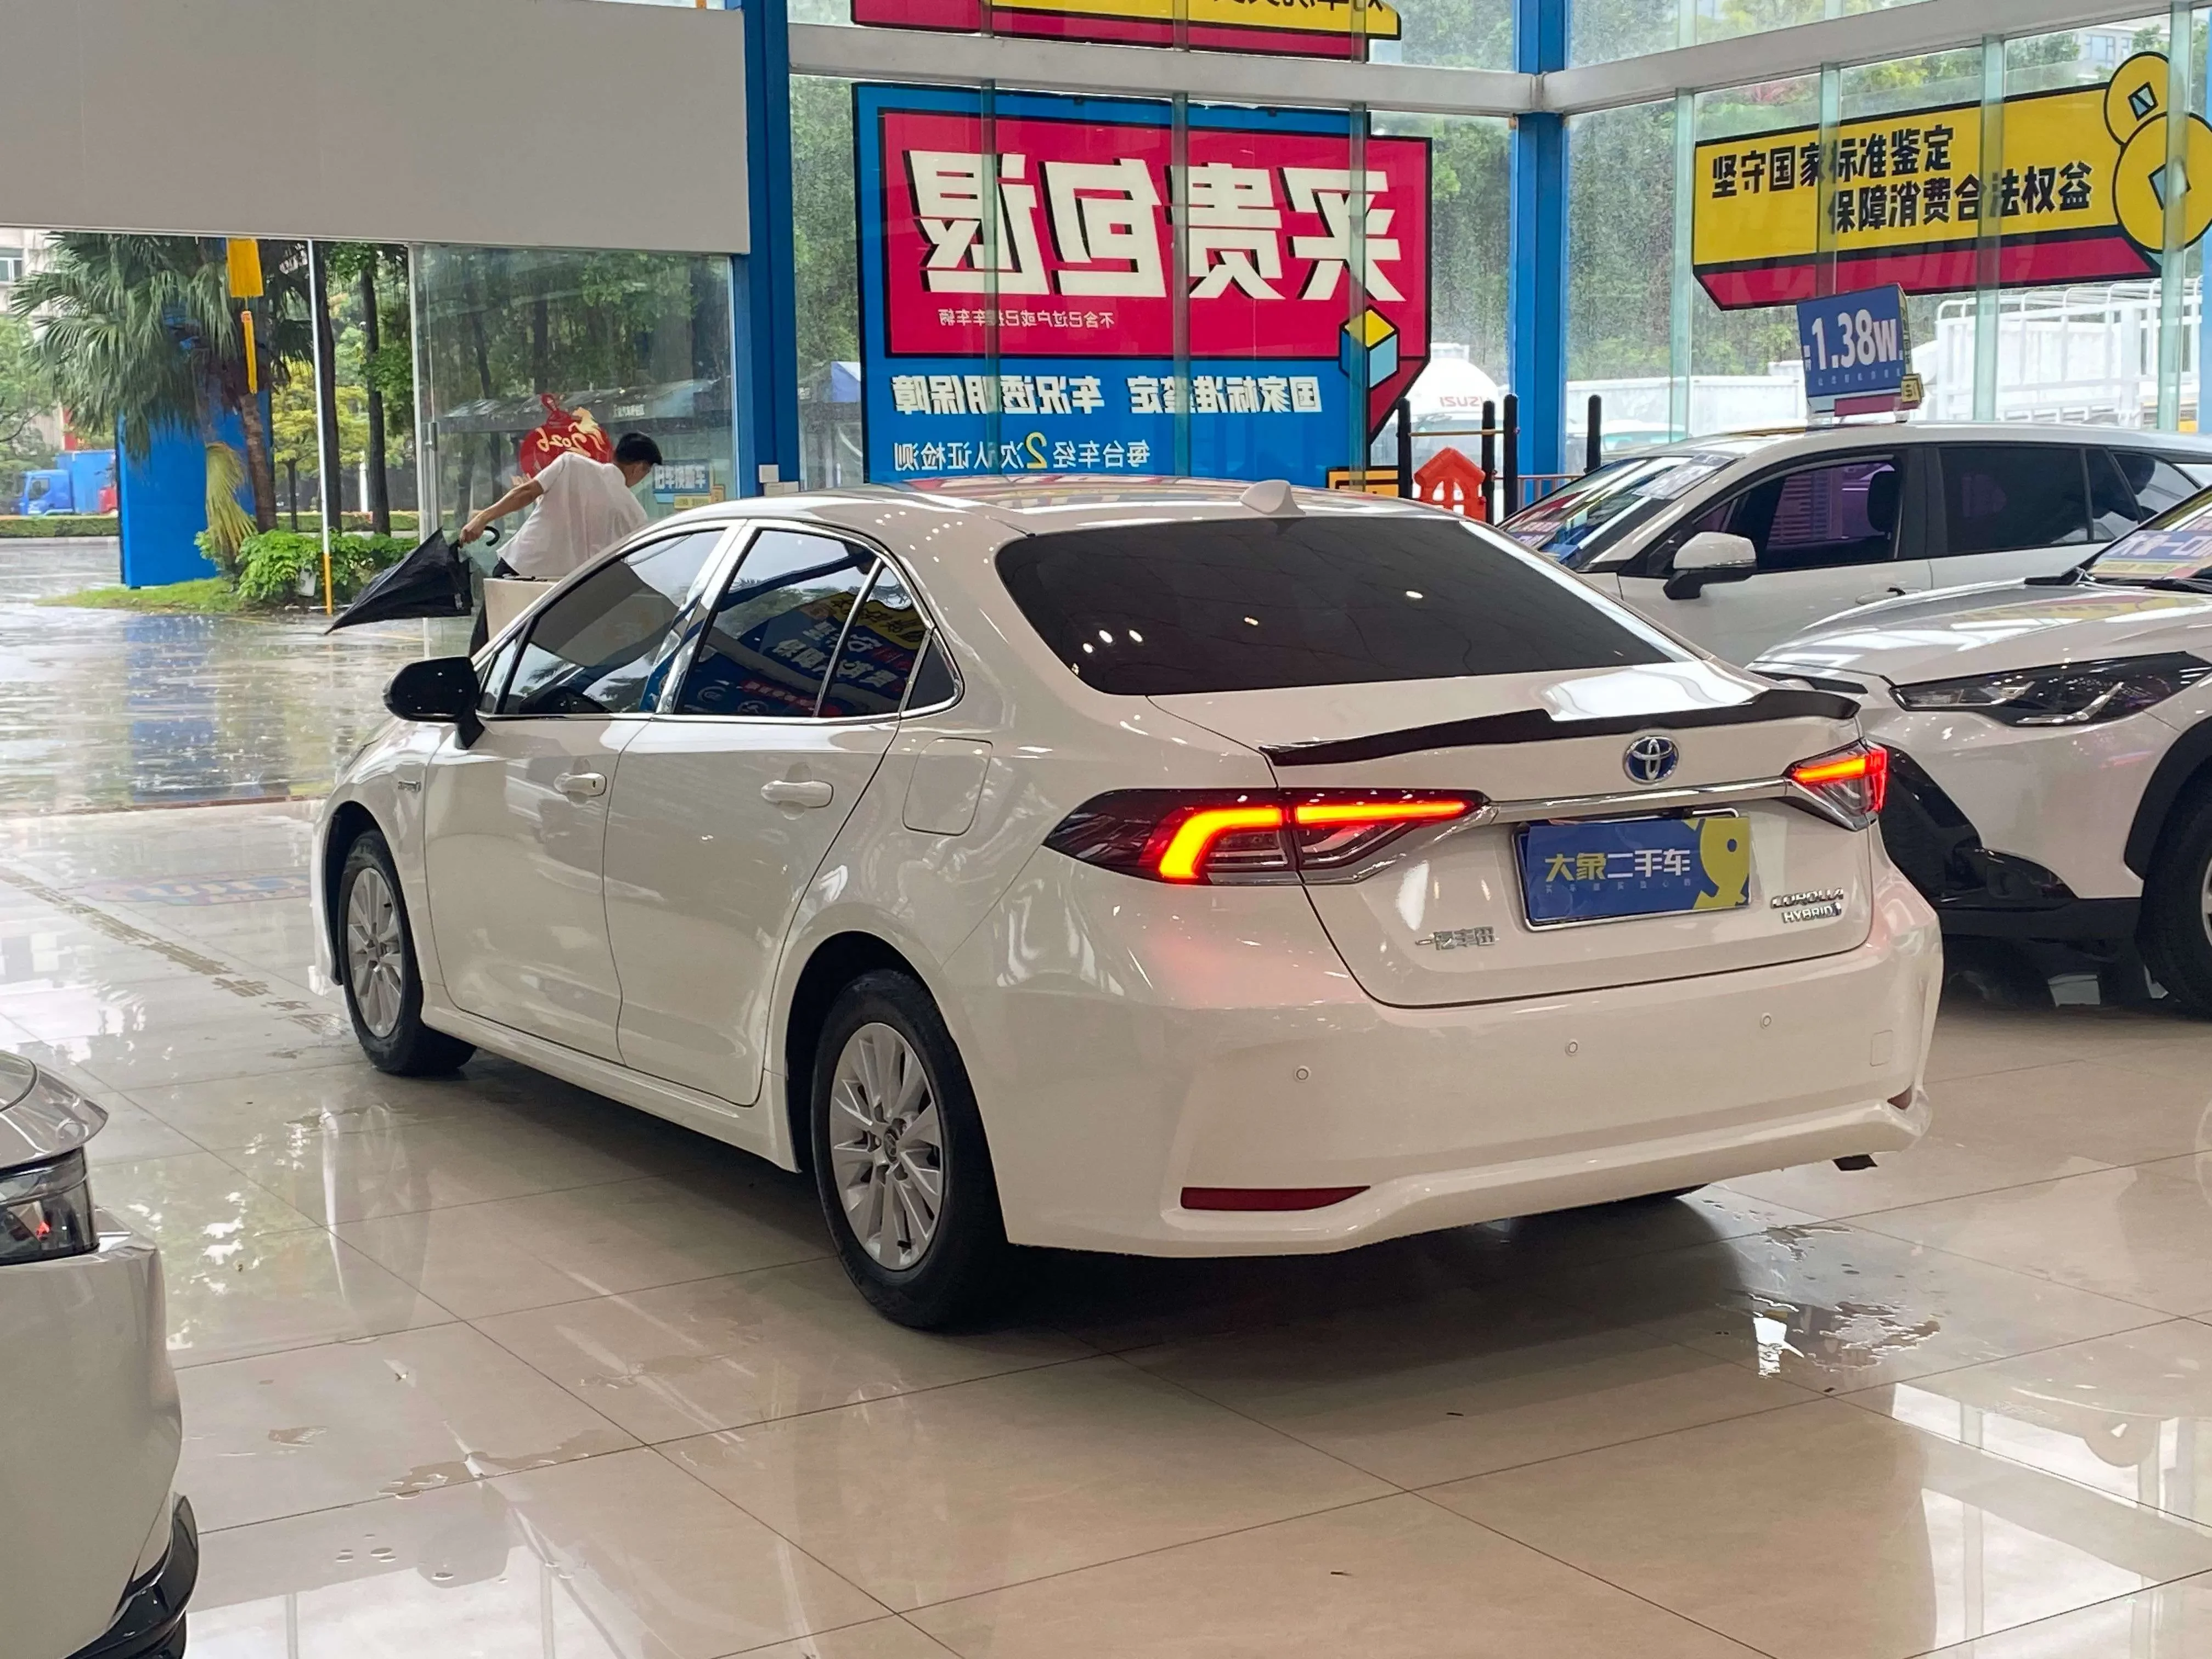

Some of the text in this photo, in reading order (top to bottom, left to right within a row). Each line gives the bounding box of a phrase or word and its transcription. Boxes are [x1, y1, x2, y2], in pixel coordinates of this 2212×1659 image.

[1712, 124, 1954, 199] 坚守国家标准鉴定
[1829, 160, 2092, 234] 保障消费合法权益
[1812, 309, 1897, 370] 1.38W
[1544, 848, 1690, 882] 大象二手车
[1771, 887, 1844, 909] COROLLA
[1782, 904, 1834, 923] HYBRID
